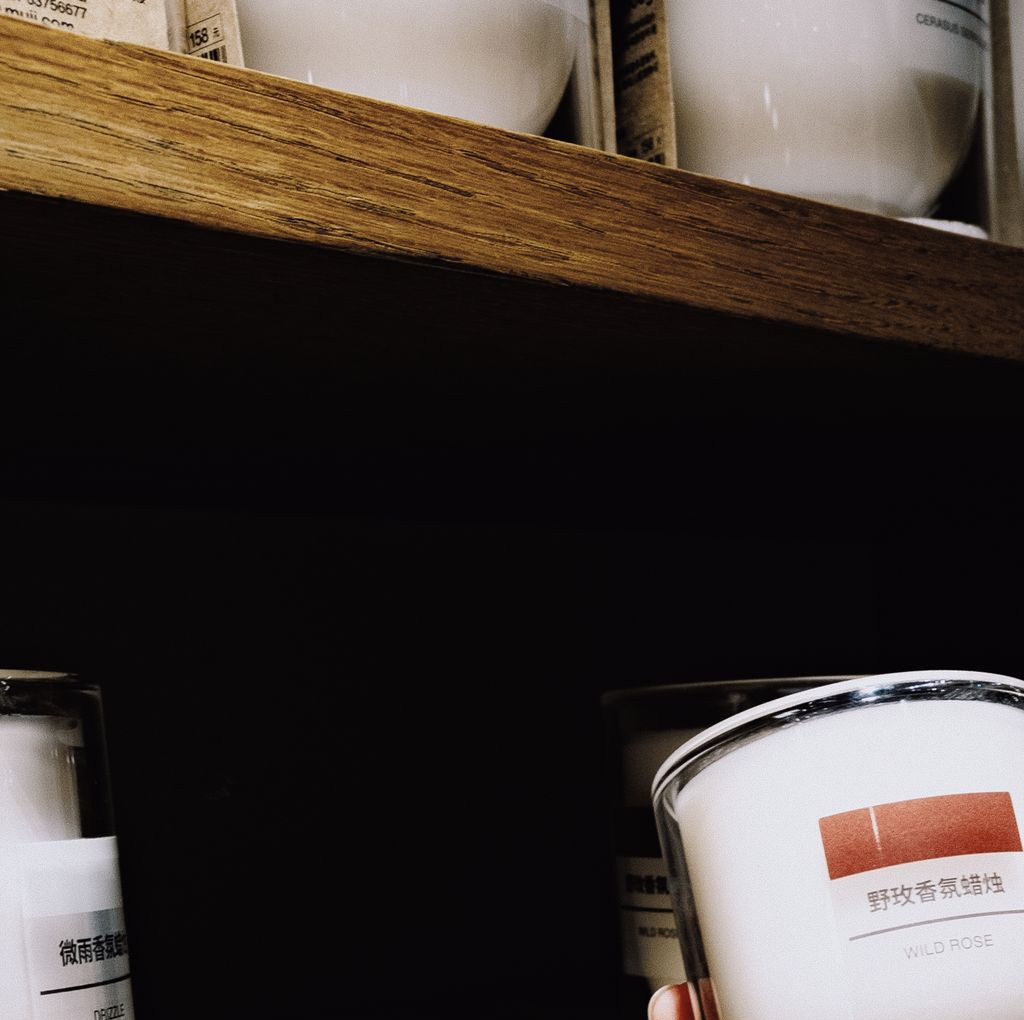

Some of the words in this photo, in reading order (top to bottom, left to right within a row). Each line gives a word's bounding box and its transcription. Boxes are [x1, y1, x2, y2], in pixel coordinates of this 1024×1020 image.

[190, 27, 209, 47] 158
[867, 872, 1006, 913] 野玫香氛蜡烛
[903, 941, 945, 959] WILD
[950, 934, 994, 952] ROSE
